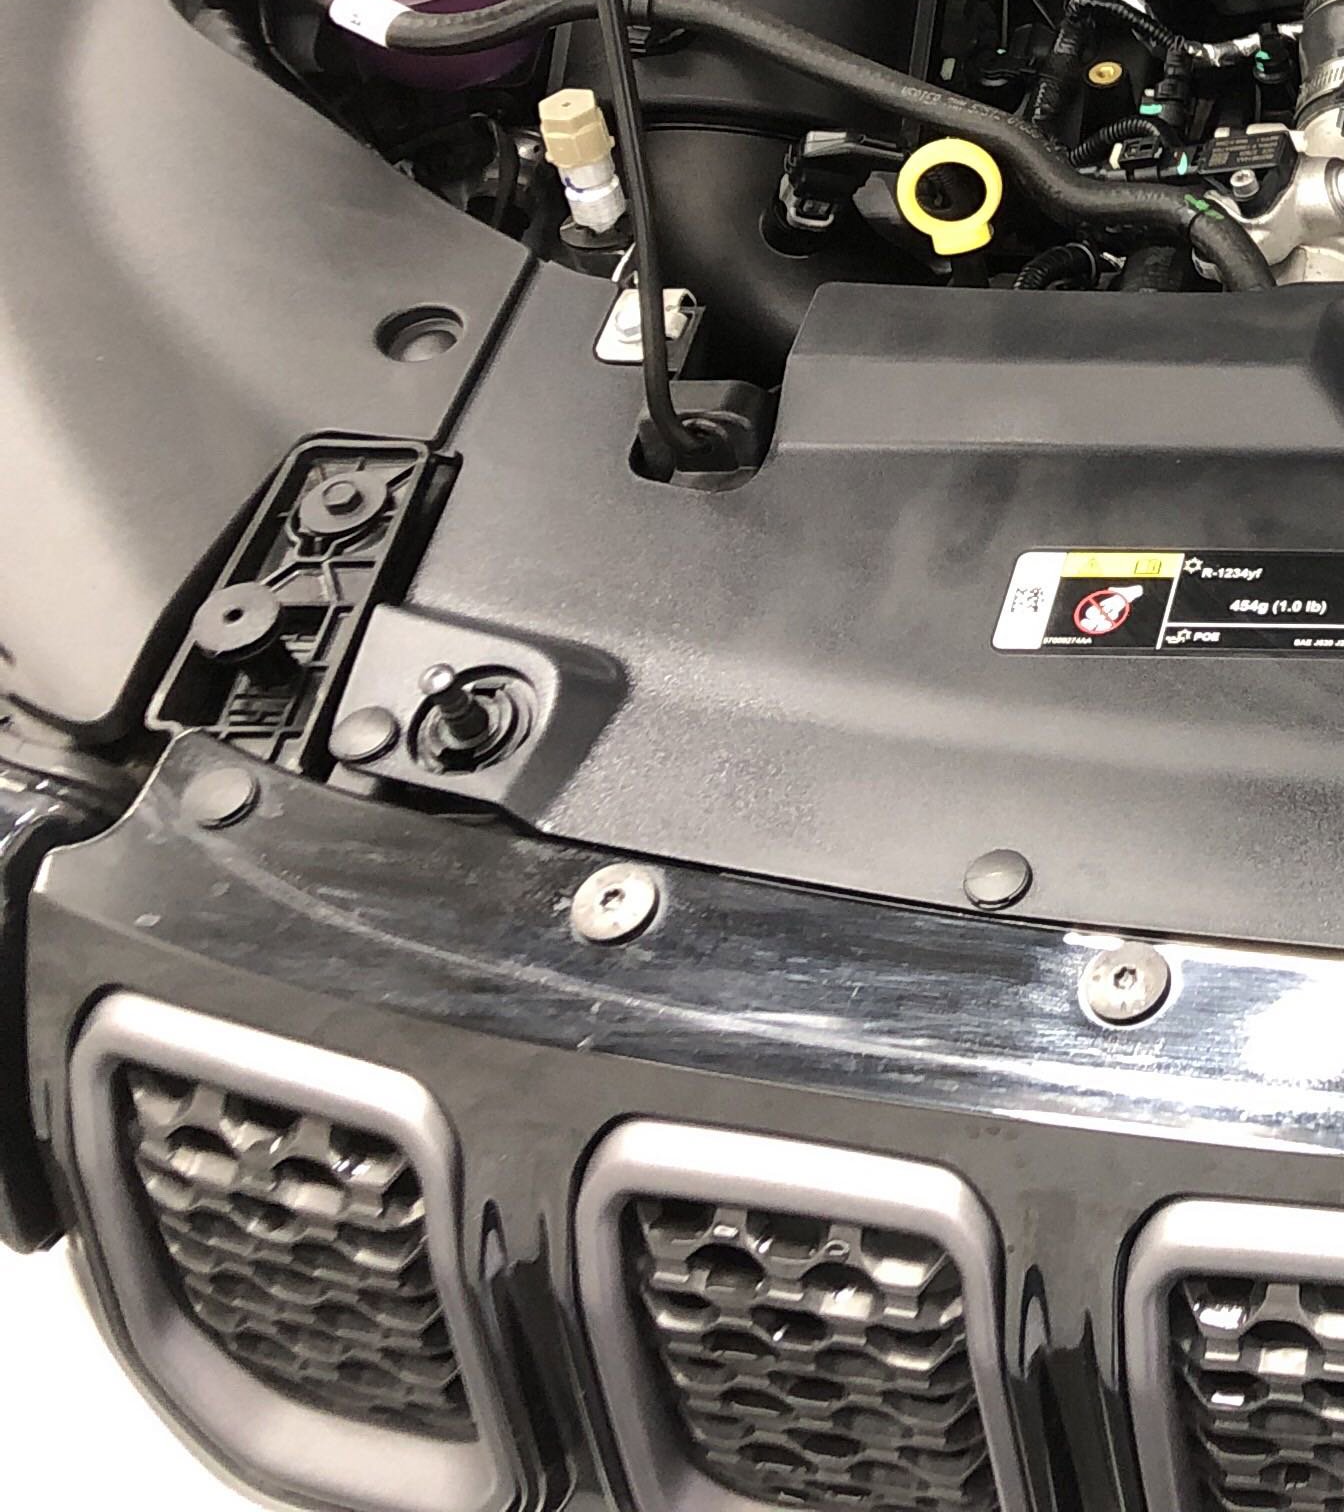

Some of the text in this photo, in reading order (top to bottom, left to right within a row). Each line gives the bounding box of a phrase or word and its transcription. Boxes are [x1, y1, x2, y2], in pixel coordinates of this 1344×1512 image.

[1201, 567, 1263, 581] R-1234yf
[1229, 599, 1328, 615] 454g (1.0 lb)
